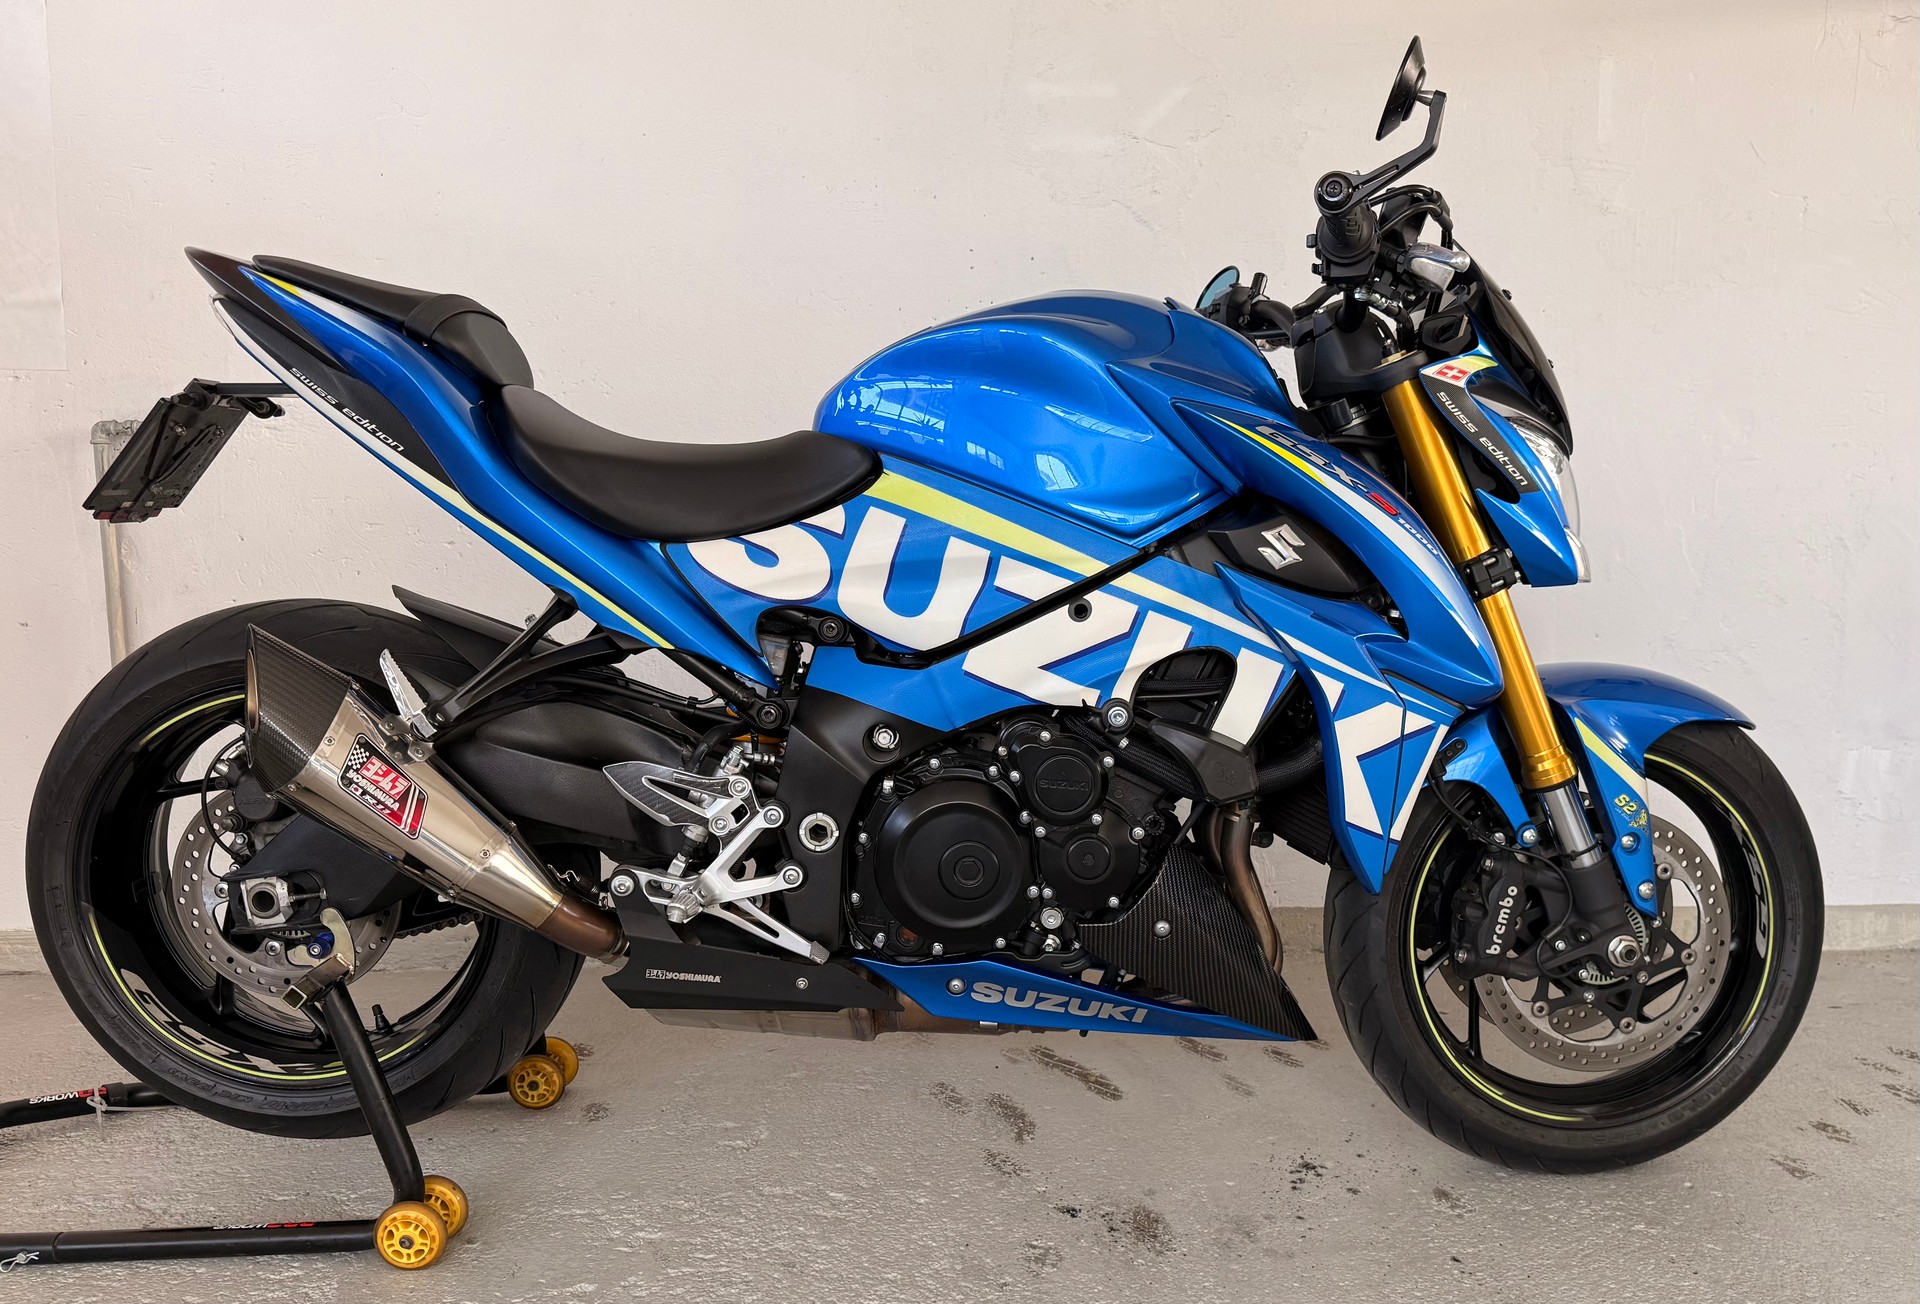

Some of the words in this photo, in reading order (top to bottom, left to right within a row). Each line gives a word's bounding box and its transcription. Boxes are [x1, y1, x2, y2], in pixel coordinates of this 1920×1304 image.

[290, 367, 338, 405] swiss
[342, 407, 404, 452] edition
[1436, 391, 1479, 433] swiss
[1479, 436, 1528, 486] edition
[1398, 516, 1439, 556] 1000
[346, 769, 400, 811] YOSHIMURA
[1038, 779, 1089, 791] SUZUKI
[1485, 885, 1518, 955] brembo
[666, 971, 721, 984] YOSHIMURA
[970, 981, 1148, 1023] SUZUKI
